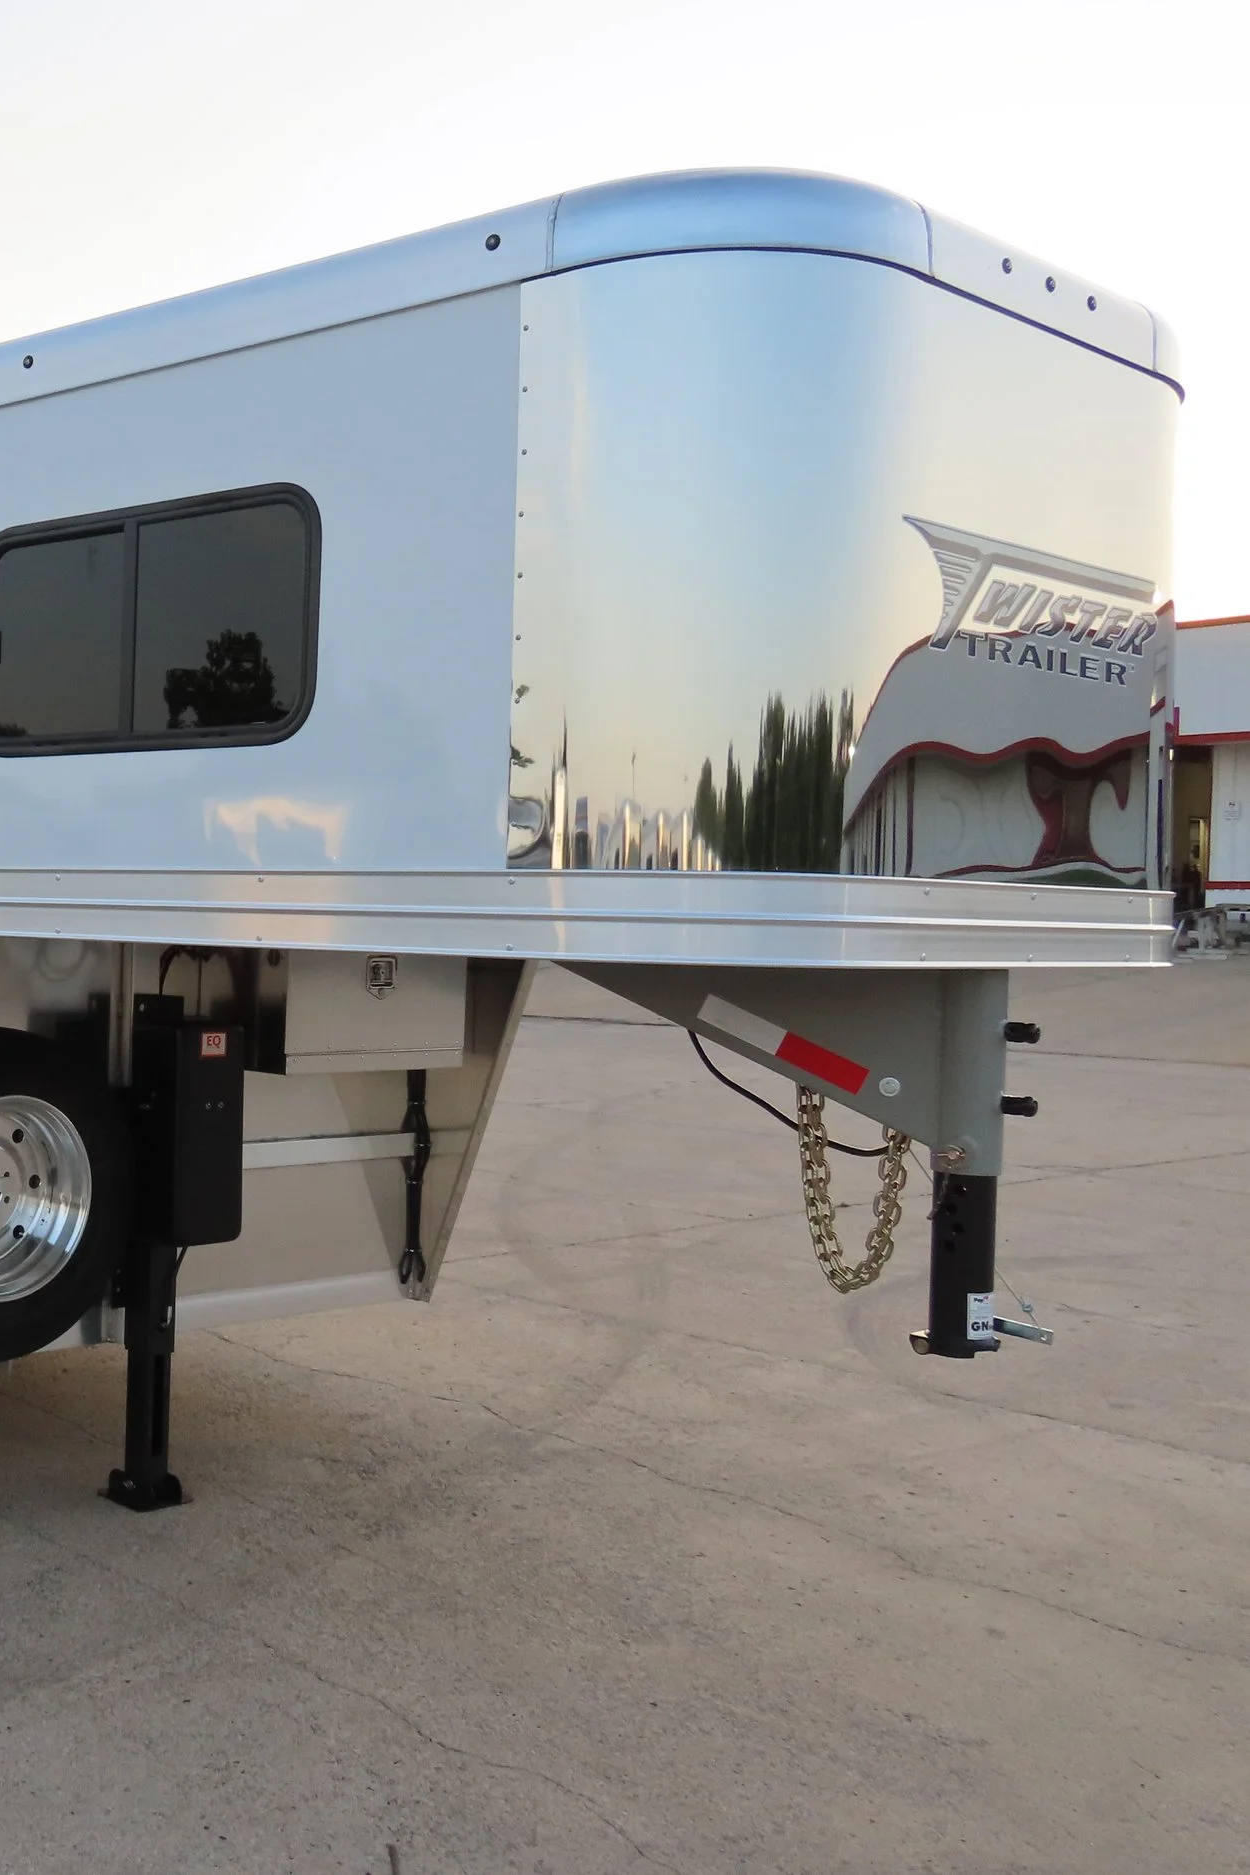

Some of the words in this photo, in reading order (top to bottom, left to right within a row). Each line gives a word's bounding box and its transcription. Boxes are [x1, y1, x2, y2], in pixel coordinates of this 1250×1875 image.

[903, 515, 1157, 656] TWISTER
[959, 630, 1126, 686] TRAILER
[206, 1035, 221, 1049] EQ
